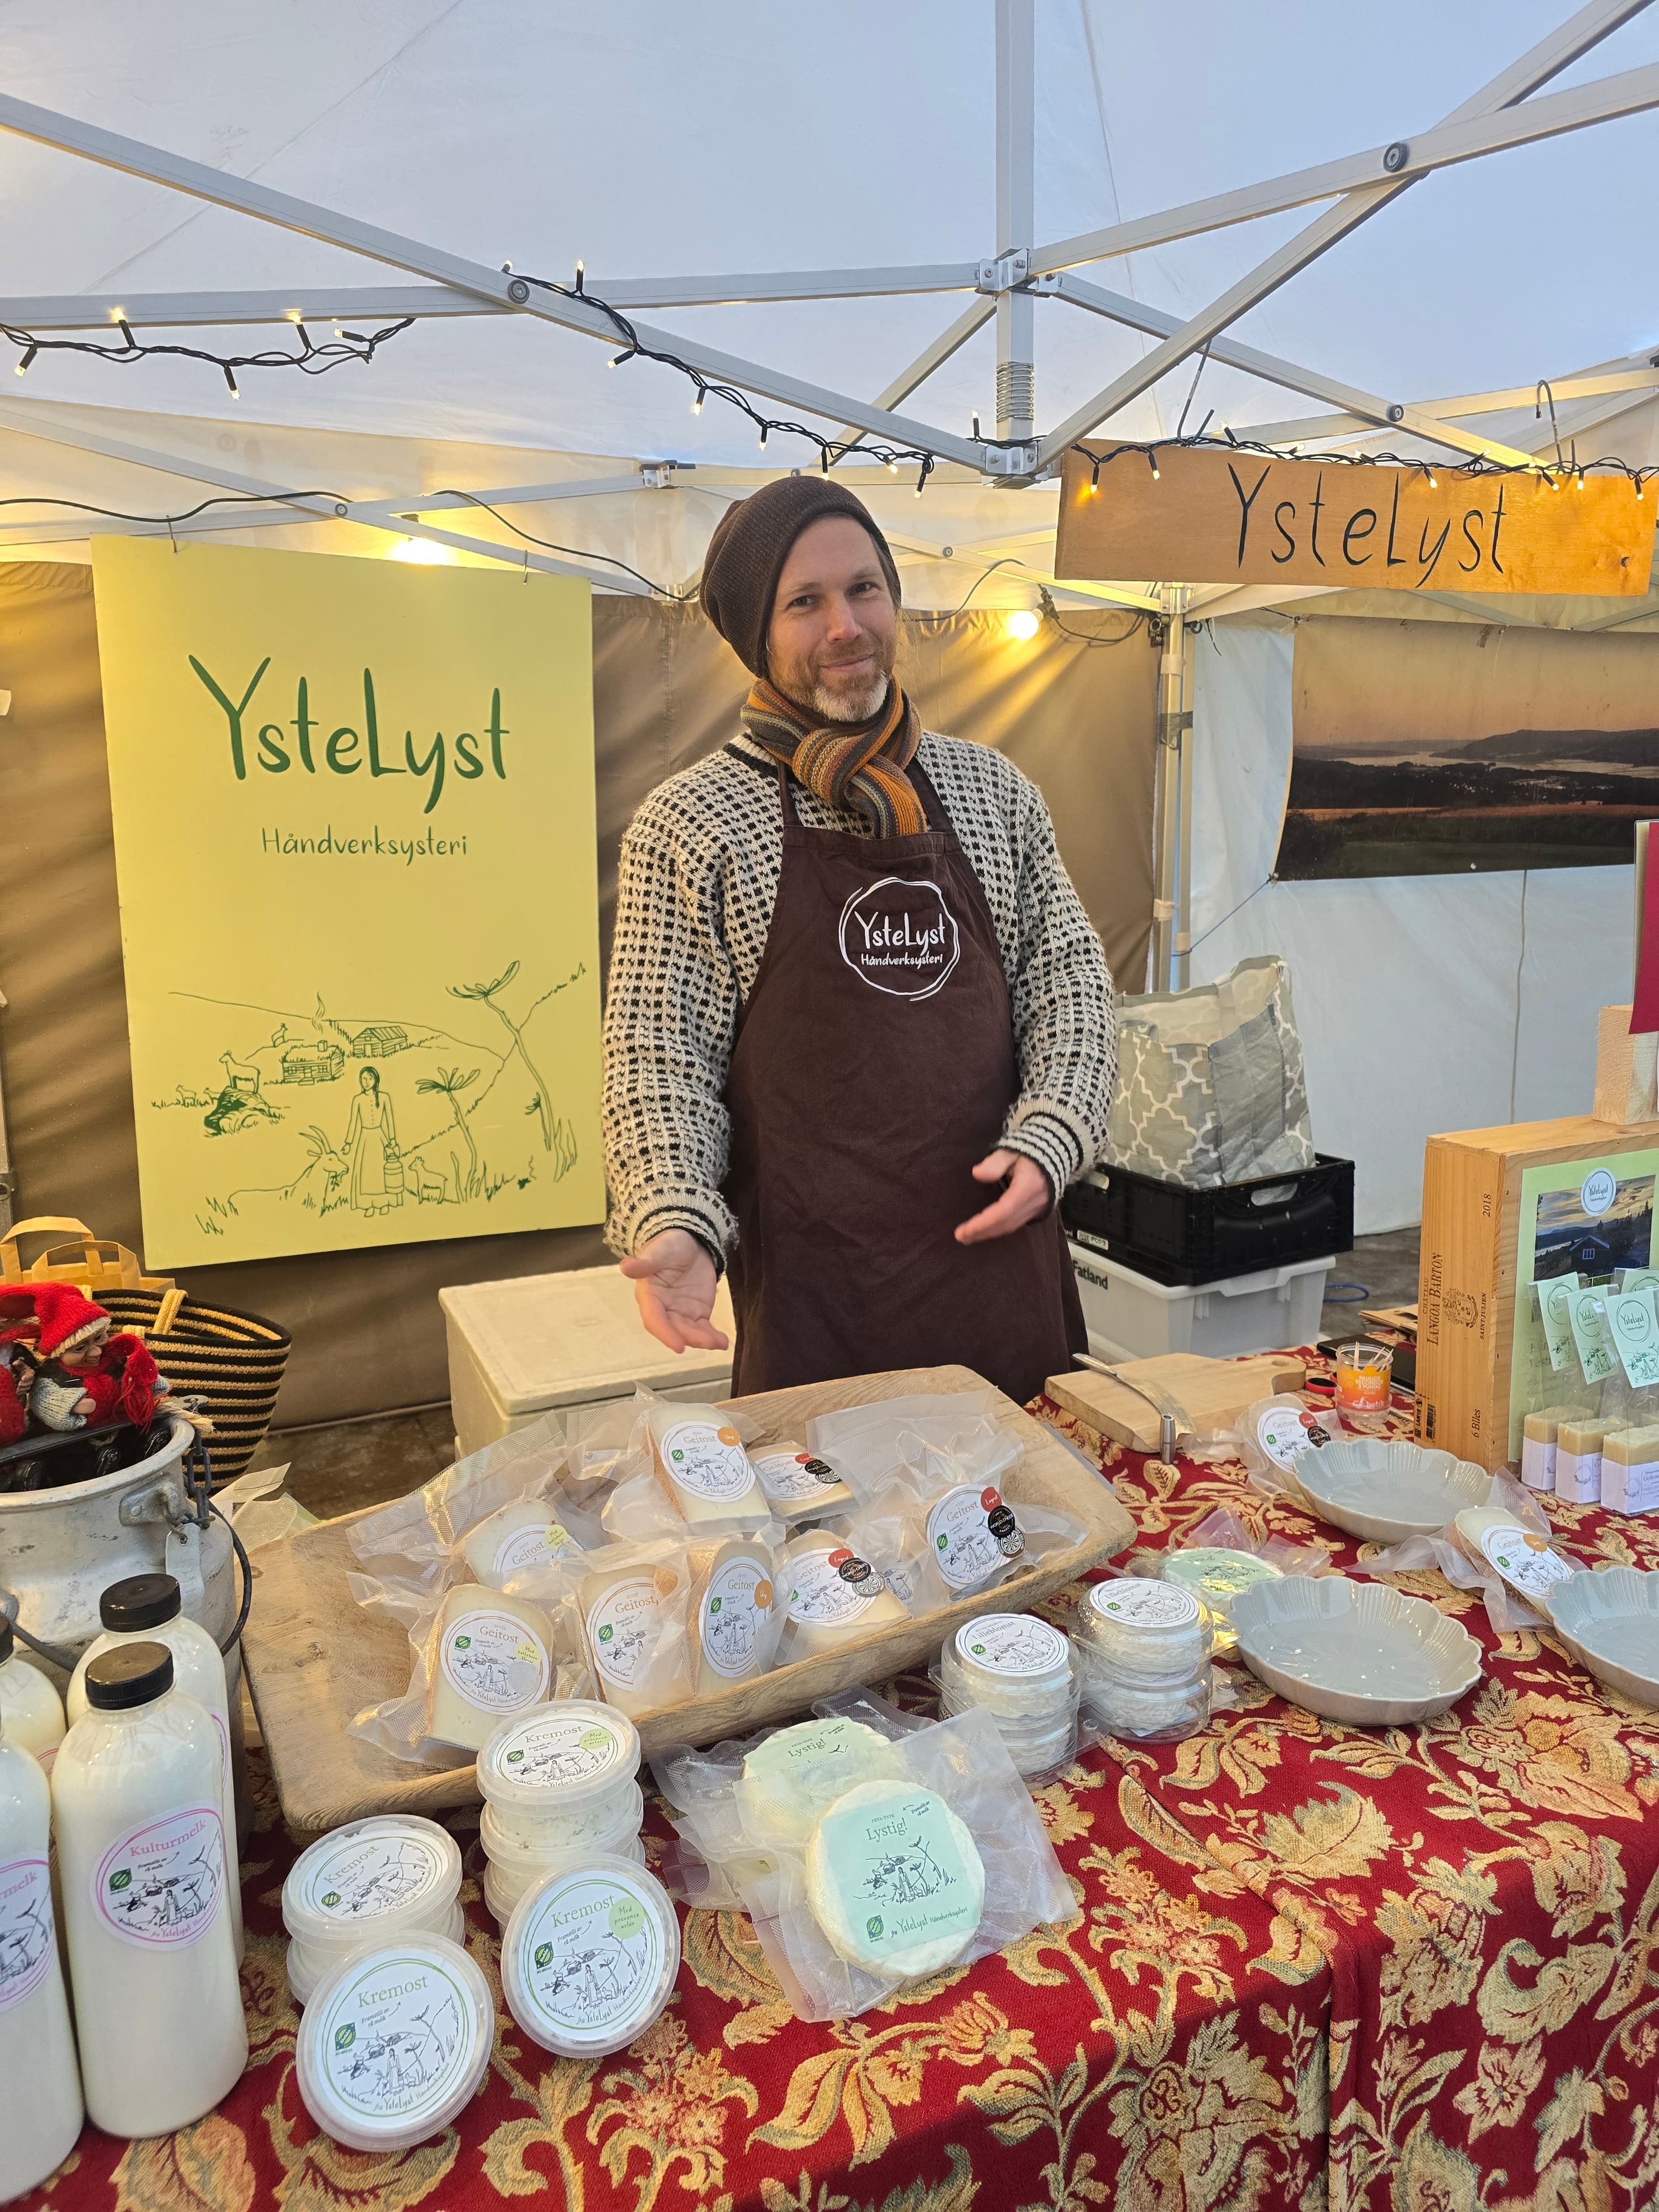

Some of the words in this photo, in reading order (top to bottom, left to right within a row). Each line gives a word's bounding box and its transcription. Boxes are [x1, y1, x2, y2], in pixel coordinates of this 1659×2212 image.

[1227, 462, 1507, 588] YsteLyst
[189, 654, 510, 815] YsteLyst
[262, 824, 467, 867] Håndverksysteri
[854, 911, 945, 956] YsteLyst
[860, 951, 943, 969] Håndverksysteri
[1482, 1193, 1491, 1218] 2018
[1428, 1252, 1443, 1300] BARTON
[1426, 1303, 1441, 1347] LANGOA
[683, 1435, 717, 1444] Geitost
[946, 1500, 979, 1523] Geitost
[512, 1540, 545, 1566] Geitost
[728, 1579, 755, 1590] Geitost
[615, 1595, 656, 1614] Geitost
[479, 1625, 519, 1644] Geitost
[972, 1620, 1016, 1640] Lilleblomst
[525, 1725, 584, 1744] Kremost
[787, 1738, 827, 1757] Lystig!
[871, 1813, 895, 1824] FETA-TYPE
[129, 1818, 206, 1858] Kulturmelk
[865, 1817, 908, 1843] Lystig!
[322, 1844, 380, 1885] Kremost
[551, 1894, 616, 1928] Kremost
[614, 1912, 640, 1925] provence
[619, 1906, 632, 1916] Med
[895, 1914, 929, 1934] YsteLyst
[358, 1975, 429, 2009] Kremost
[585, 2006, 613, 2023] YsteLyst
[384, 2095, 415, 2112] YsteLyst
